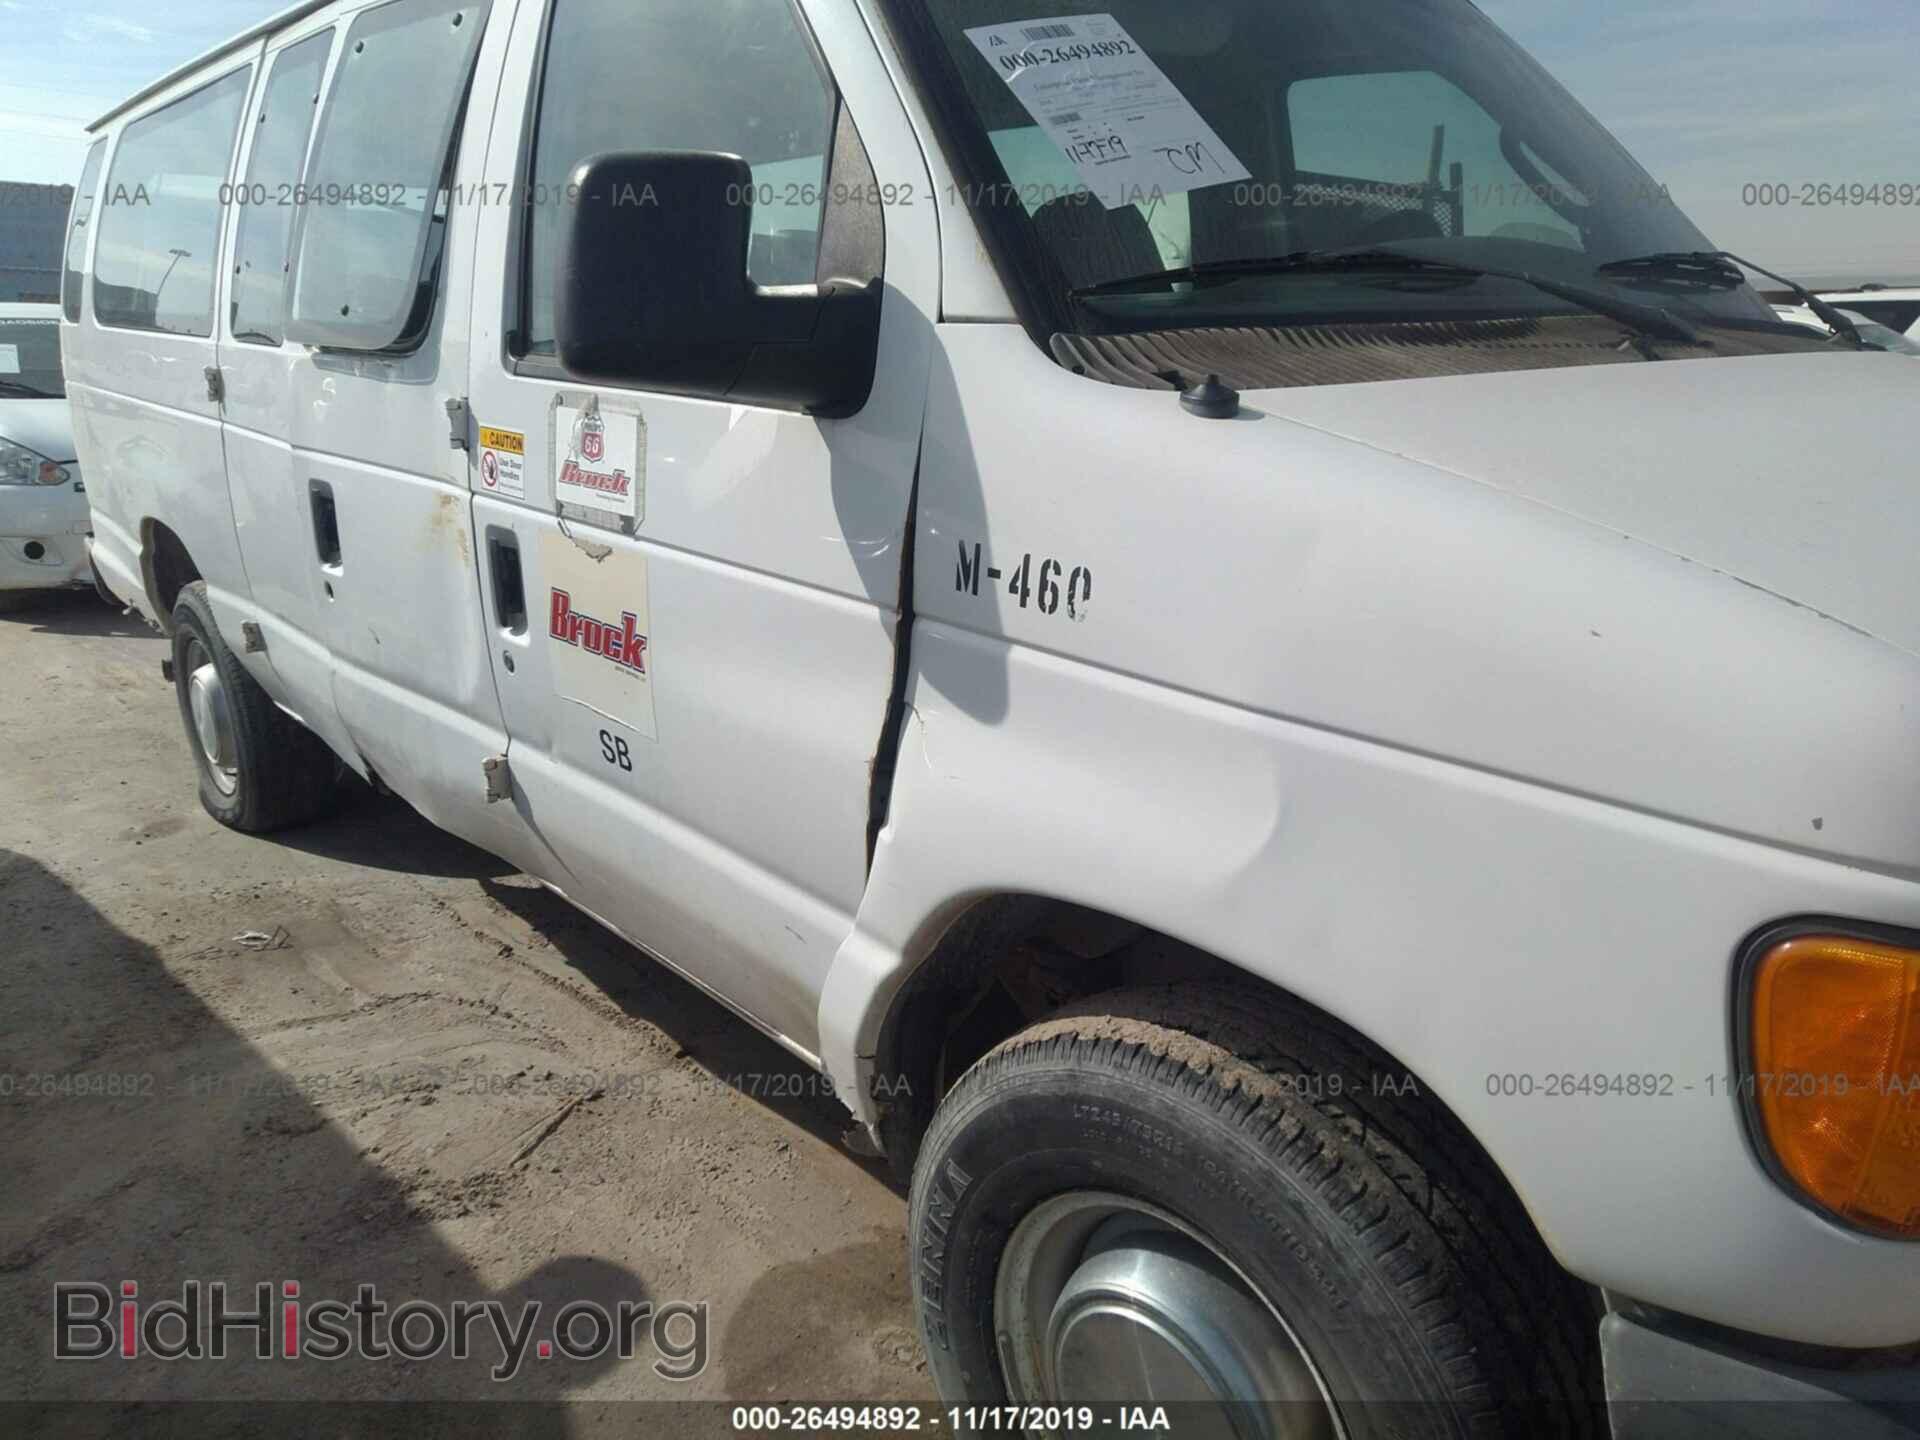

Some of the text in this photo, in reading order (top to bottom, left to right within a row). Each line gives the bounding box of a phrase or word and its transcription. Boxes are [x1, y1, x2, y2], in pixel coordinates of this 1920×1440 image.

[999, 40, 1137, 72] 000-26494892
[488, 430, 523, 452] CAUTION
[584, 435, 600, 454] 66
[955, 539, 1092, 622] M-460
[549, 586, 647, 674] Brock
[599, 729, 632, 772] SB
